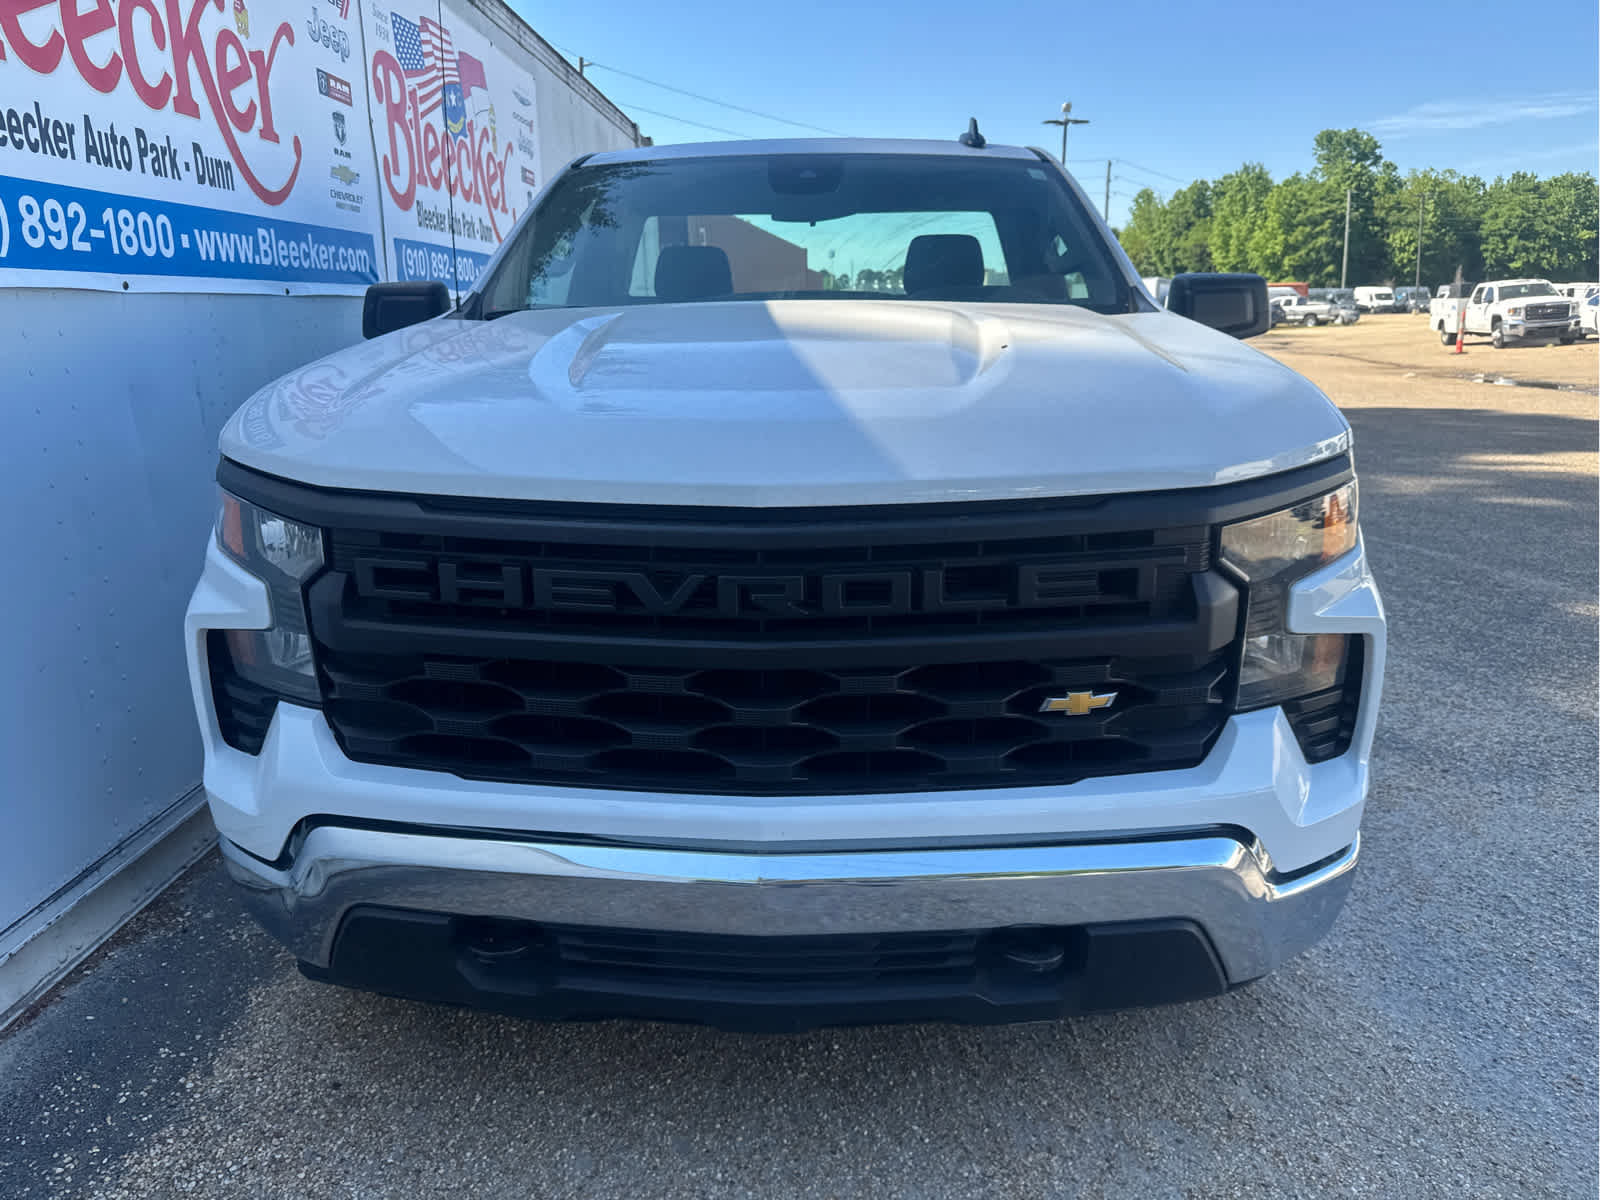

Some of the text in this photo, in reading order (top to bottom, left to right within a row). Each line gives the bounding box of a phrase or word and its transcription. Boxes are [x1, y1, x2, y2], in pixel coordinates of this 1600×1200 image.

[306, 6, 350, 63] Jeep
[0, 0, 302, 206] eecker
[84, 114, 132, 172] Auto
[135, 127, 182, 181] Park
[192, 142, 235, 191] Dunn
[334, 147, 351, 160] RAM
[372, 50, 516, 246] Bleecker
[18, 195, 175, 258] 892-1800
[194, 227, 371, 273] www.Bleecker.com
[416, 199, 446, 233] Bleecker
[462, 211, 476, 239] Park
[402, 244, 475, 282] (910) 892-800
[354, 555, 1187, 616] CHEVROLET
